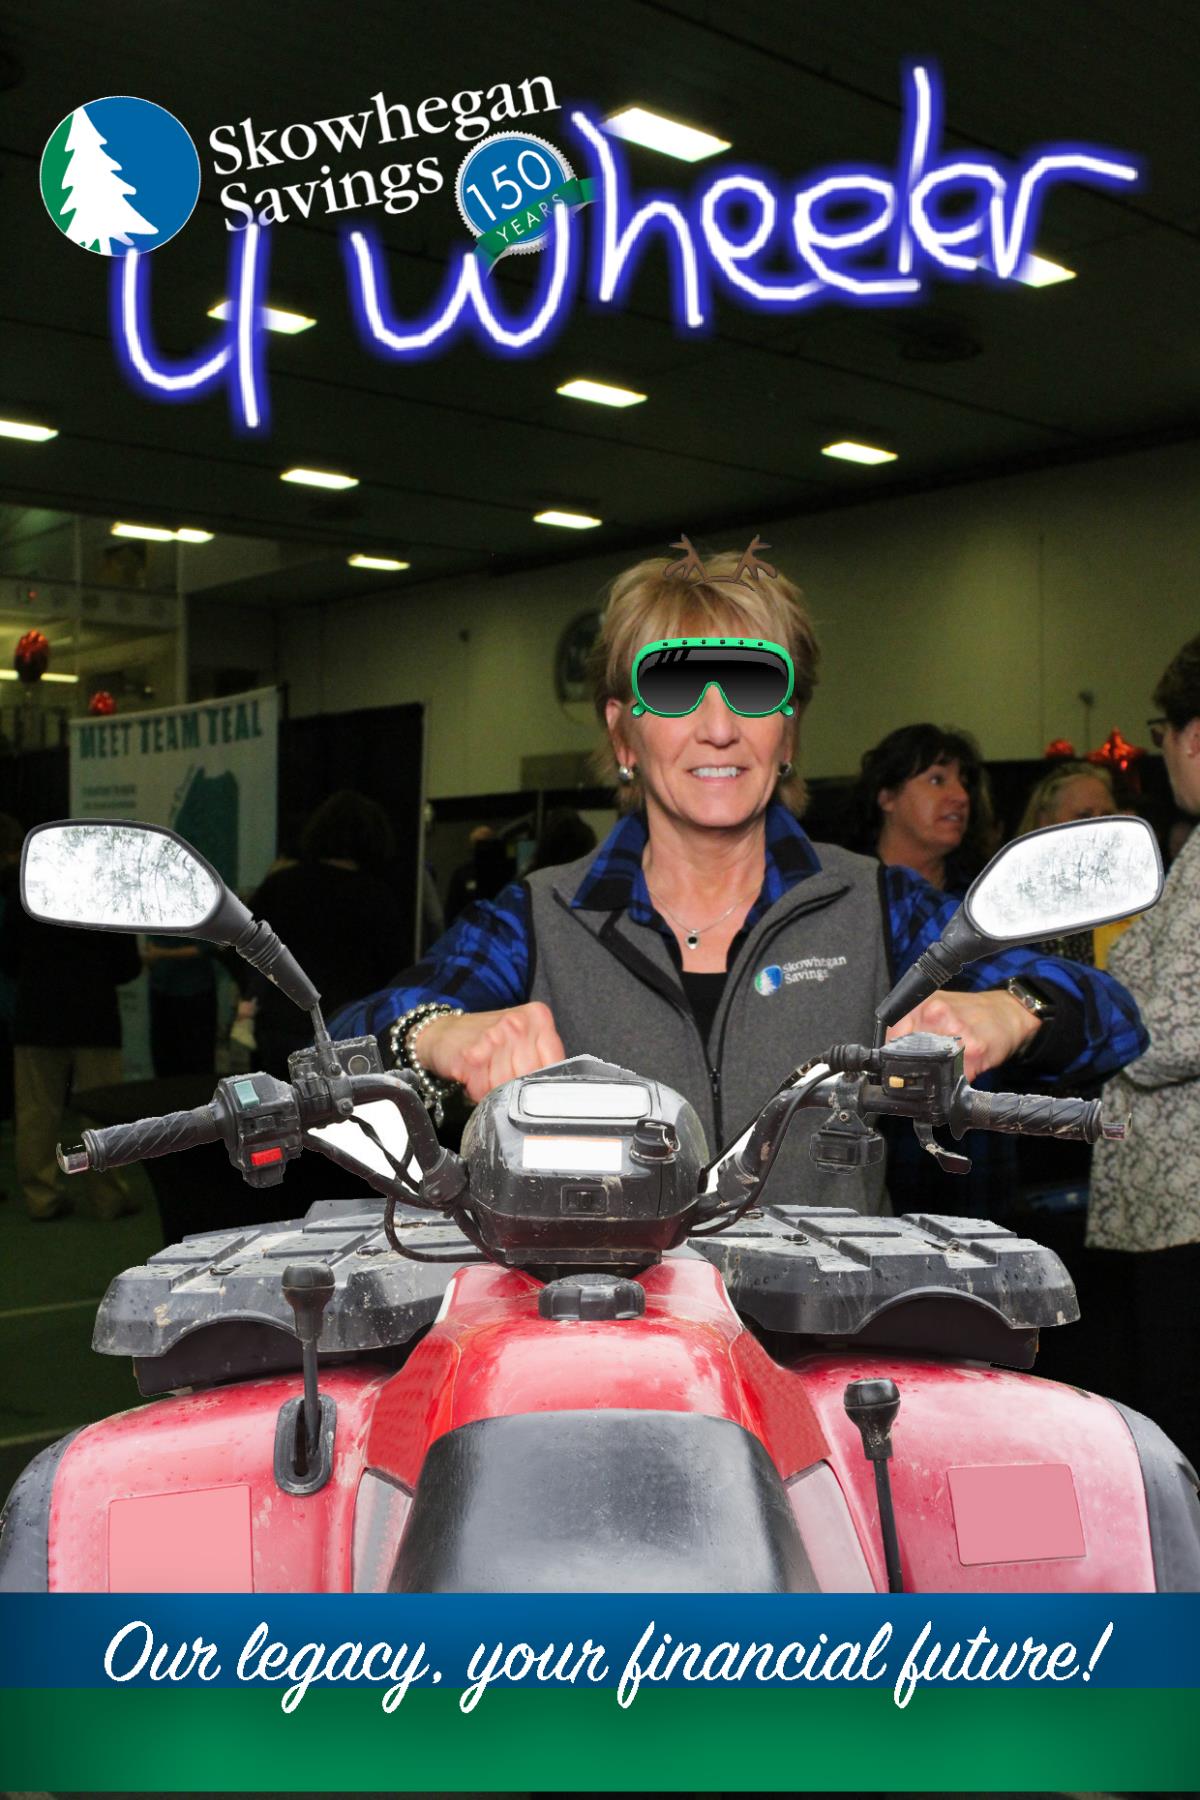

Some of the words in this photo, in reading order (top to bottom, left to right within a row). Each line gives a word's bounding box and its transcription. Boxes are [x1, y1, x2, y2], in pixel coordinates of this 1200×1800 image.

[80, 720, 130, 759] MEET
[139, 711, 199, 754] TEAM
[206, 700, 263, 746] TEAL
[782, 956, 847, 974] Skowhegan
[784, 968, 829, 985] Savings
